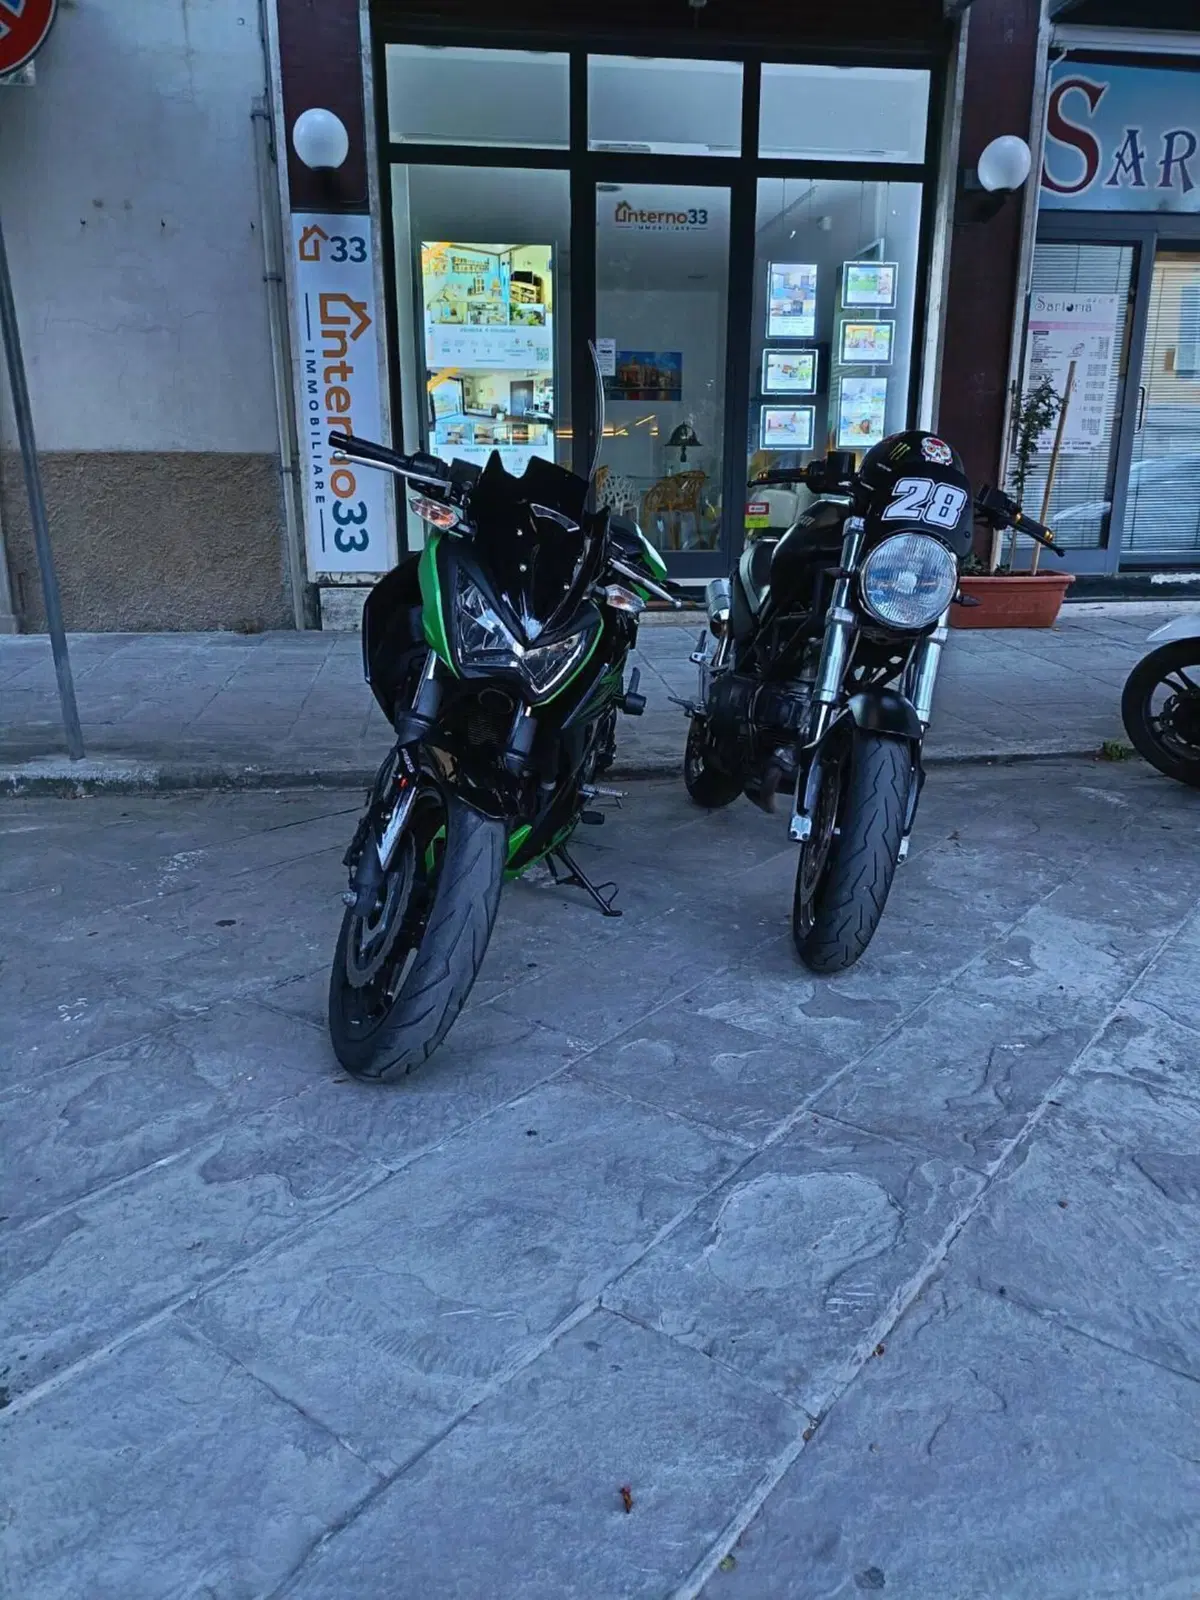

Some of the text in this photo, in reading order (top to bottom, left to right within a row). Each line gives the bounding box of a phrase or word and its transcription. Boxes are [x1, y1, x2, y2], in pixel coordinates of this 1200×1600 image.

[1041, 76, 1198, 196] SAR
[304, 348, 326, 504] IMMOBILIARE
[881, 477, 967, 530] 28
